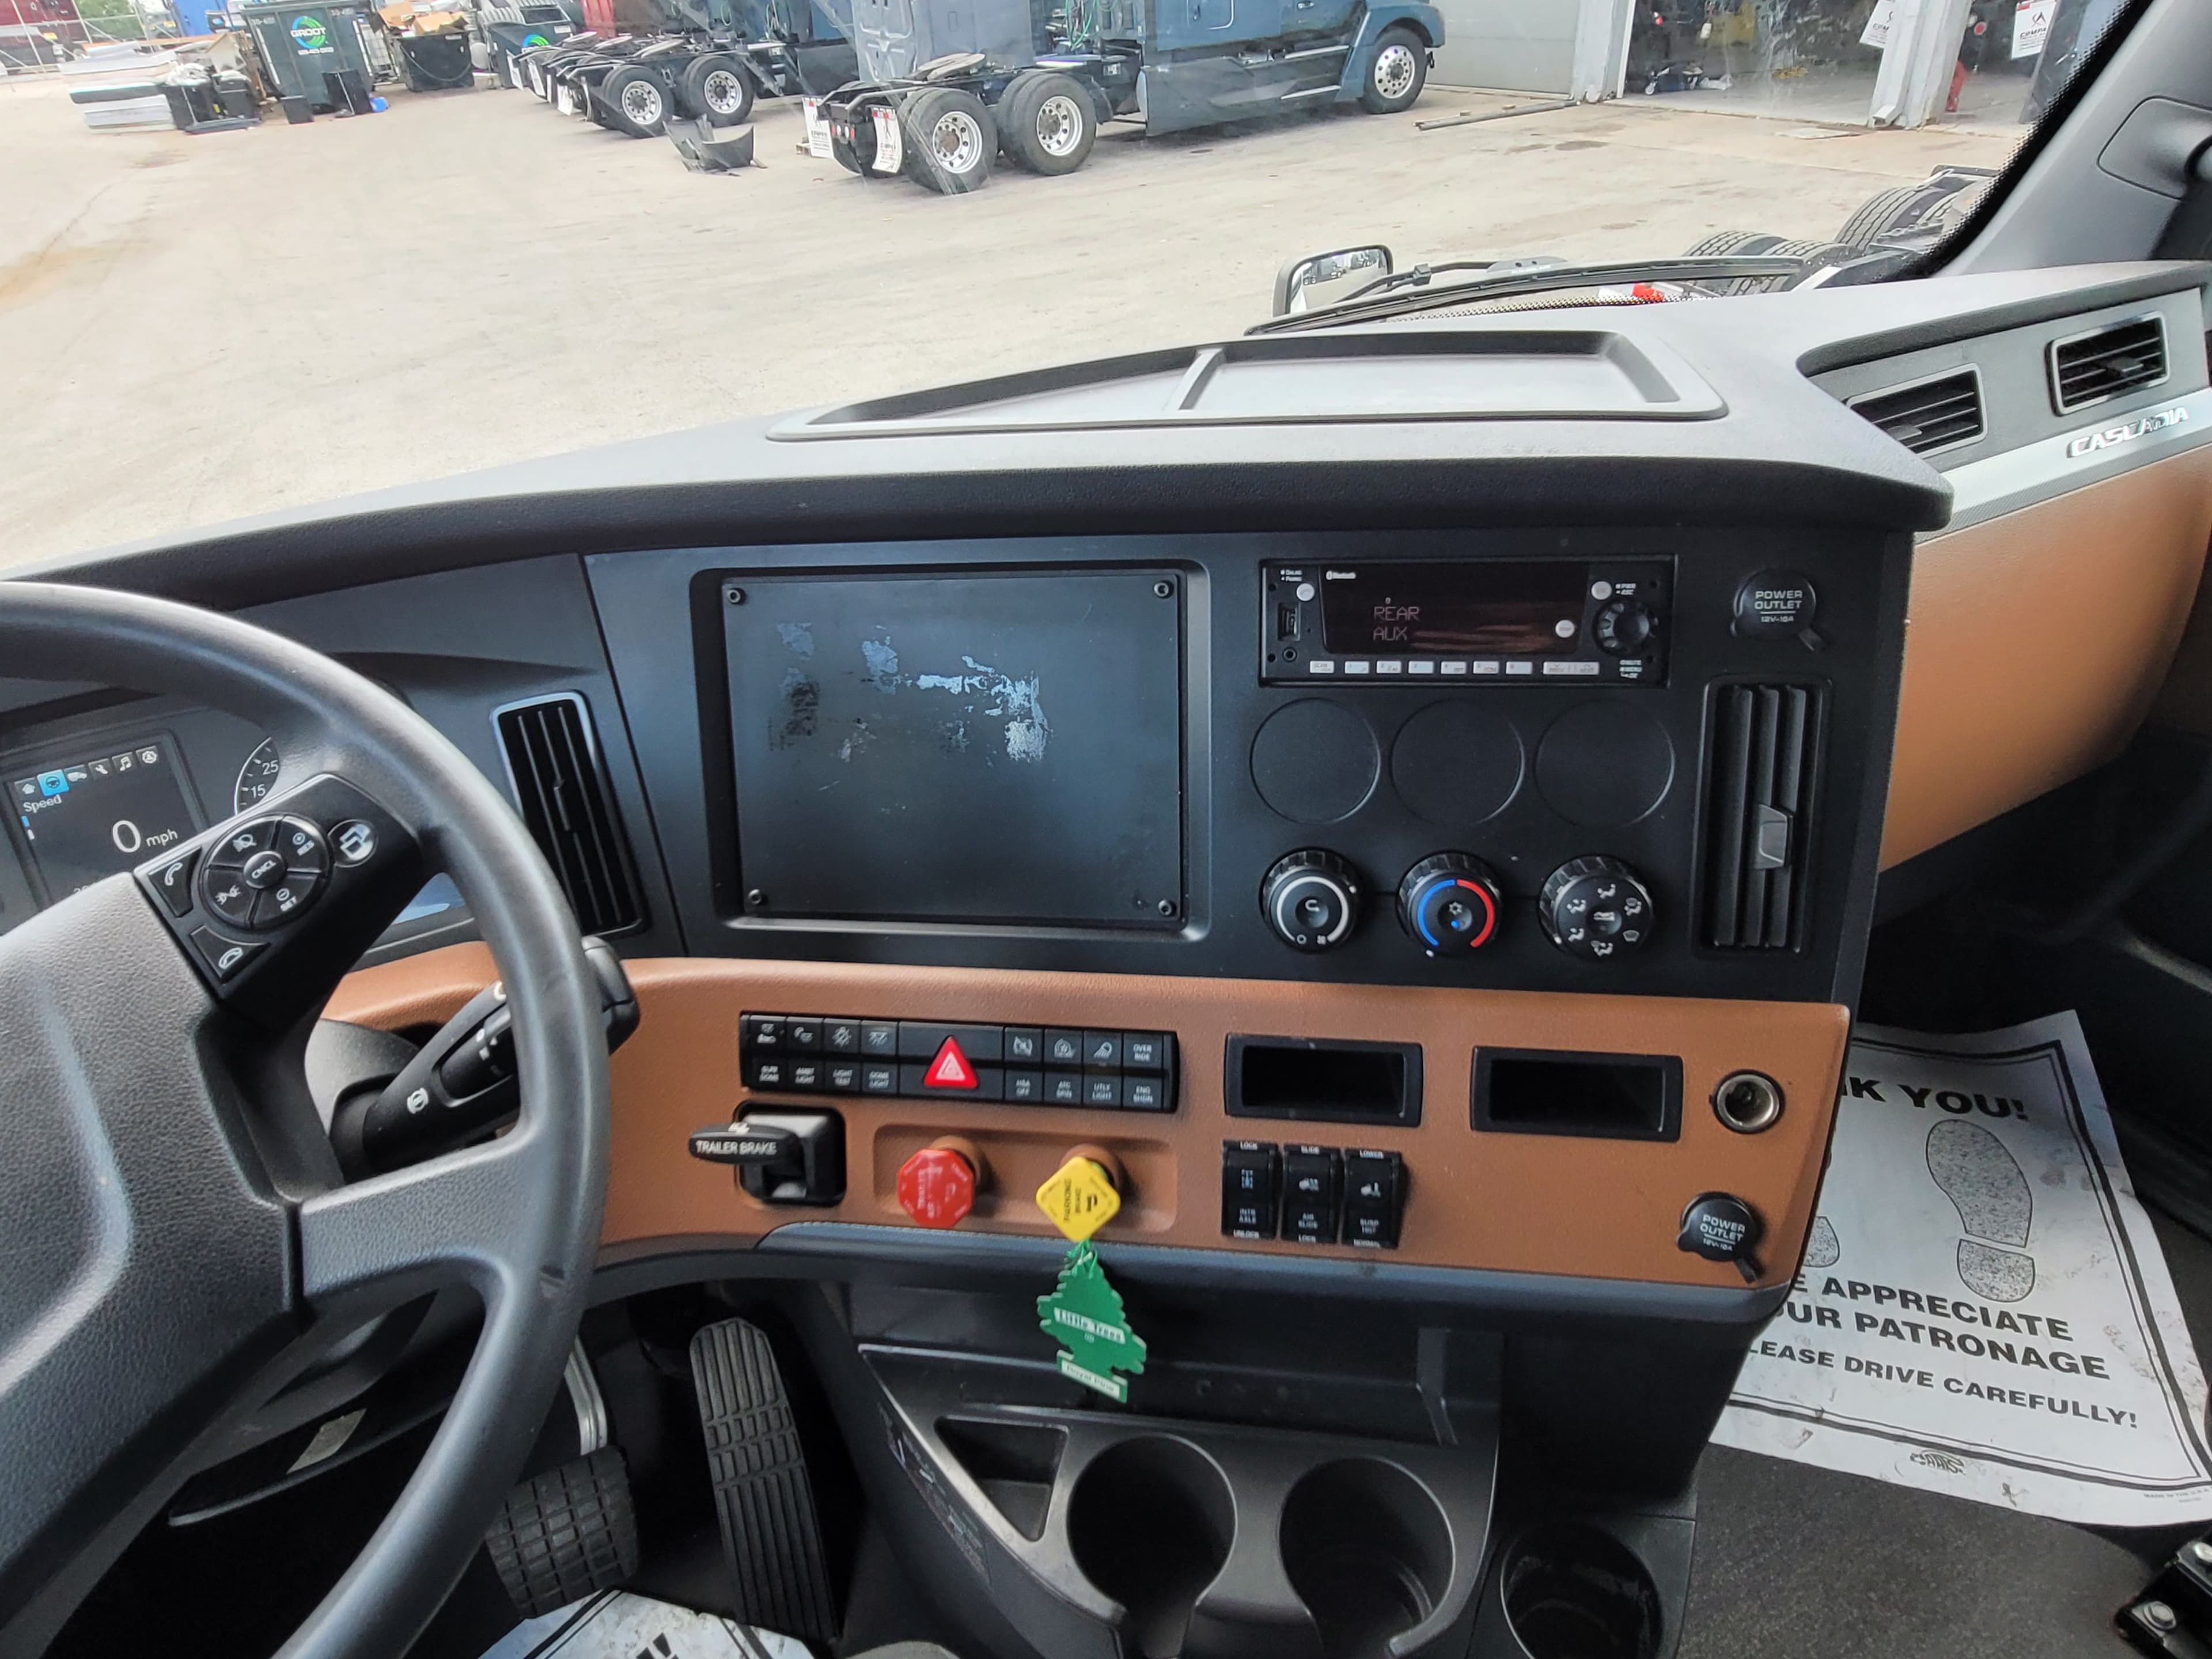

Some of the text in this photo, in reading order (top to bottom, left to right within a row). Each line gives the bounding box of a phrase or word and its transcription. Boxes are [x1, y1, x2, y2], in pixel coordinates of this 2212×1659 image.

[290, 27, 326, 37] GROOT
[2067, 407, 2190, 458] CASCADIA
[1755, 590, 1802, 599] POWER
[1754, 600, 1802, 609] OUTLET
[1374, 607, 1420, 621] REAR
[1373, 627, 1407, 641] AUX
[262, 760, 279, 775] 25
[251, 783, 266, 798] 15
[23, 794, 62, 813] Speed
[112, 820, 178, 853] 0 mph
[280, 896, 298, 912] SET
[1897, 1084, 2030, 1122] YOU!
[695, 1141, 777, 1155] TRAILER BRAKE
[1700, 1223, 1743, 1241] OUTLET
[1703, 1214, 1745, 1233] POWER
[1792, 1273, 2074, 1342] E APPRECIATE
[1854, 1312, 2111, 1380] PATRONAGE
[1844, 1355, 1934, 1388] DRIVE
[1944, 1378, 2137, 1429] CAREFULLY!
